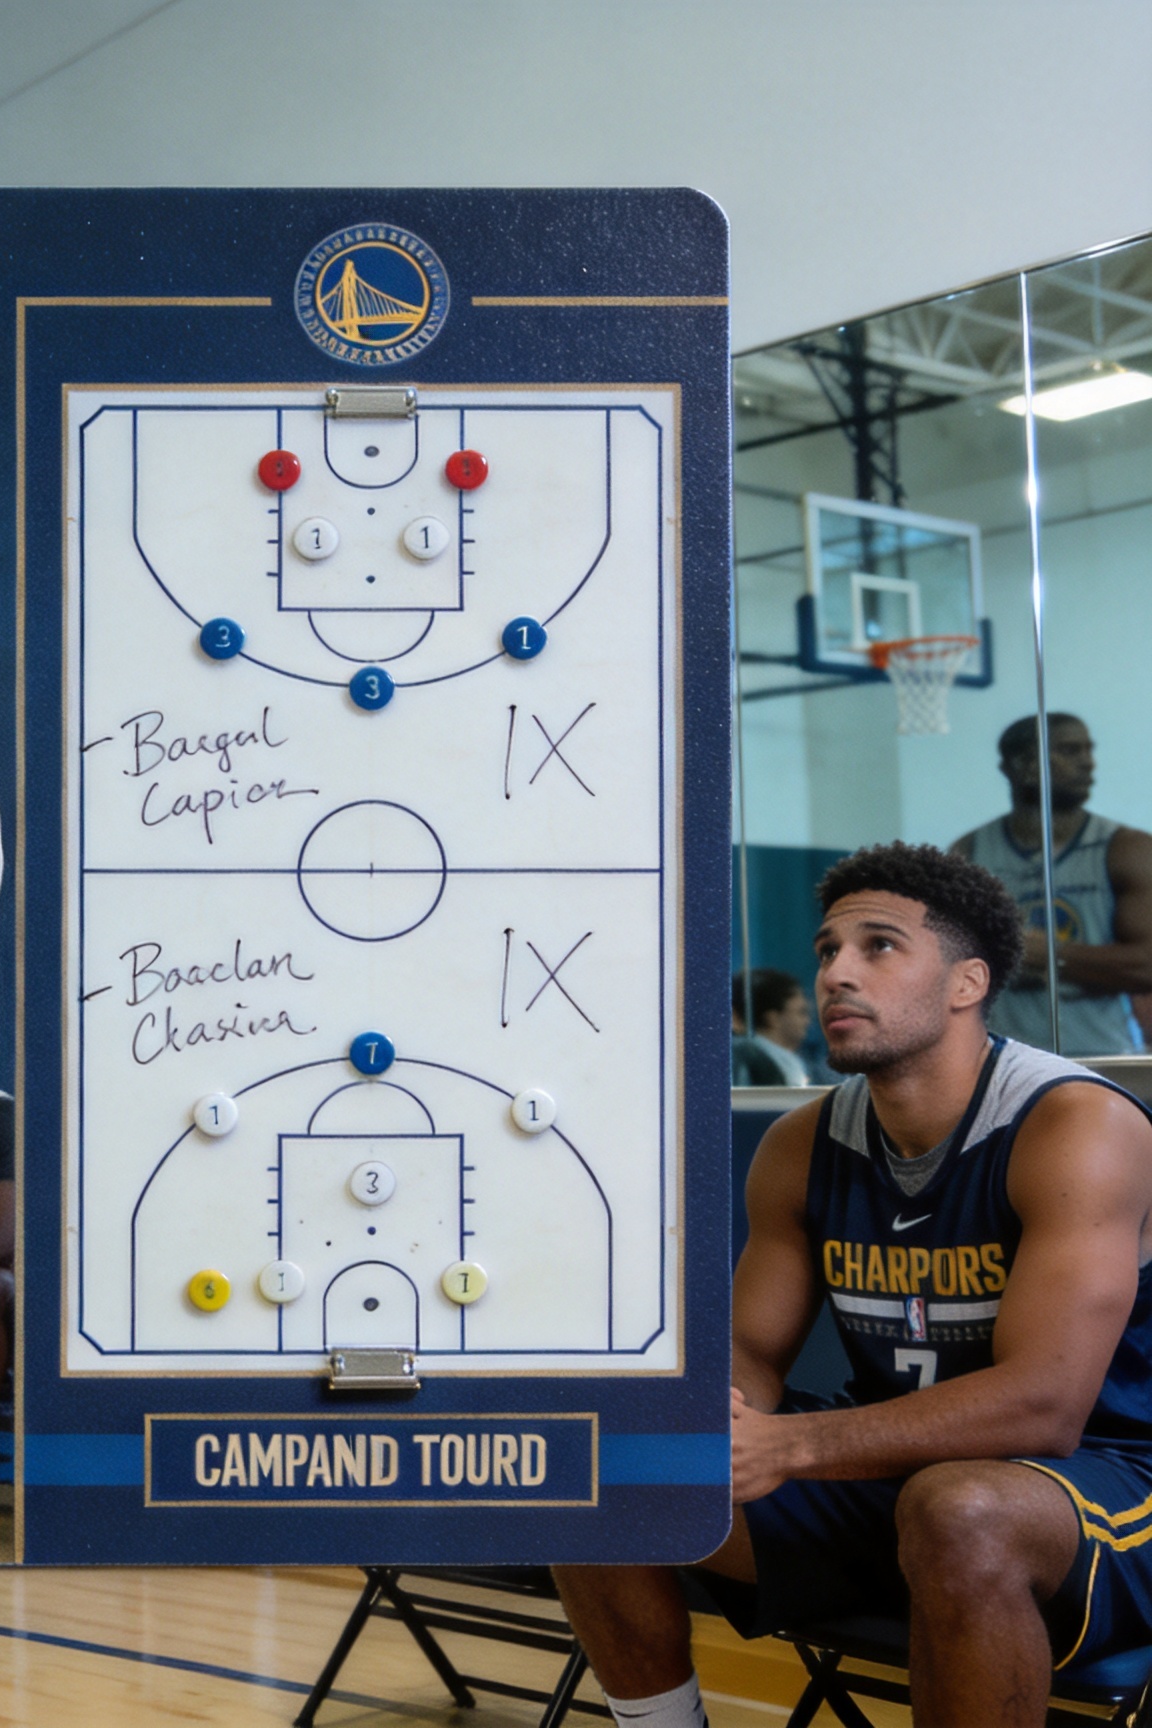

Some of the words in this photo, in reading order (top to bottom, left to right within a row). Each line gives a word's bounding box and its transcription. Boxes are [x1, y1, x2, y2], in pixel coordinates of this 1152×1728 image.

[364, 675, 381, 700] 3
[528, 1099, 540, 1122] 1
[365, 1171, 380, 1195] 3
[823, 1239, 1008, 1296] CHARPORS
[195, 1433, 399, 1488] CAMPAND
[413, 1433, 548, 1487] TOURD
